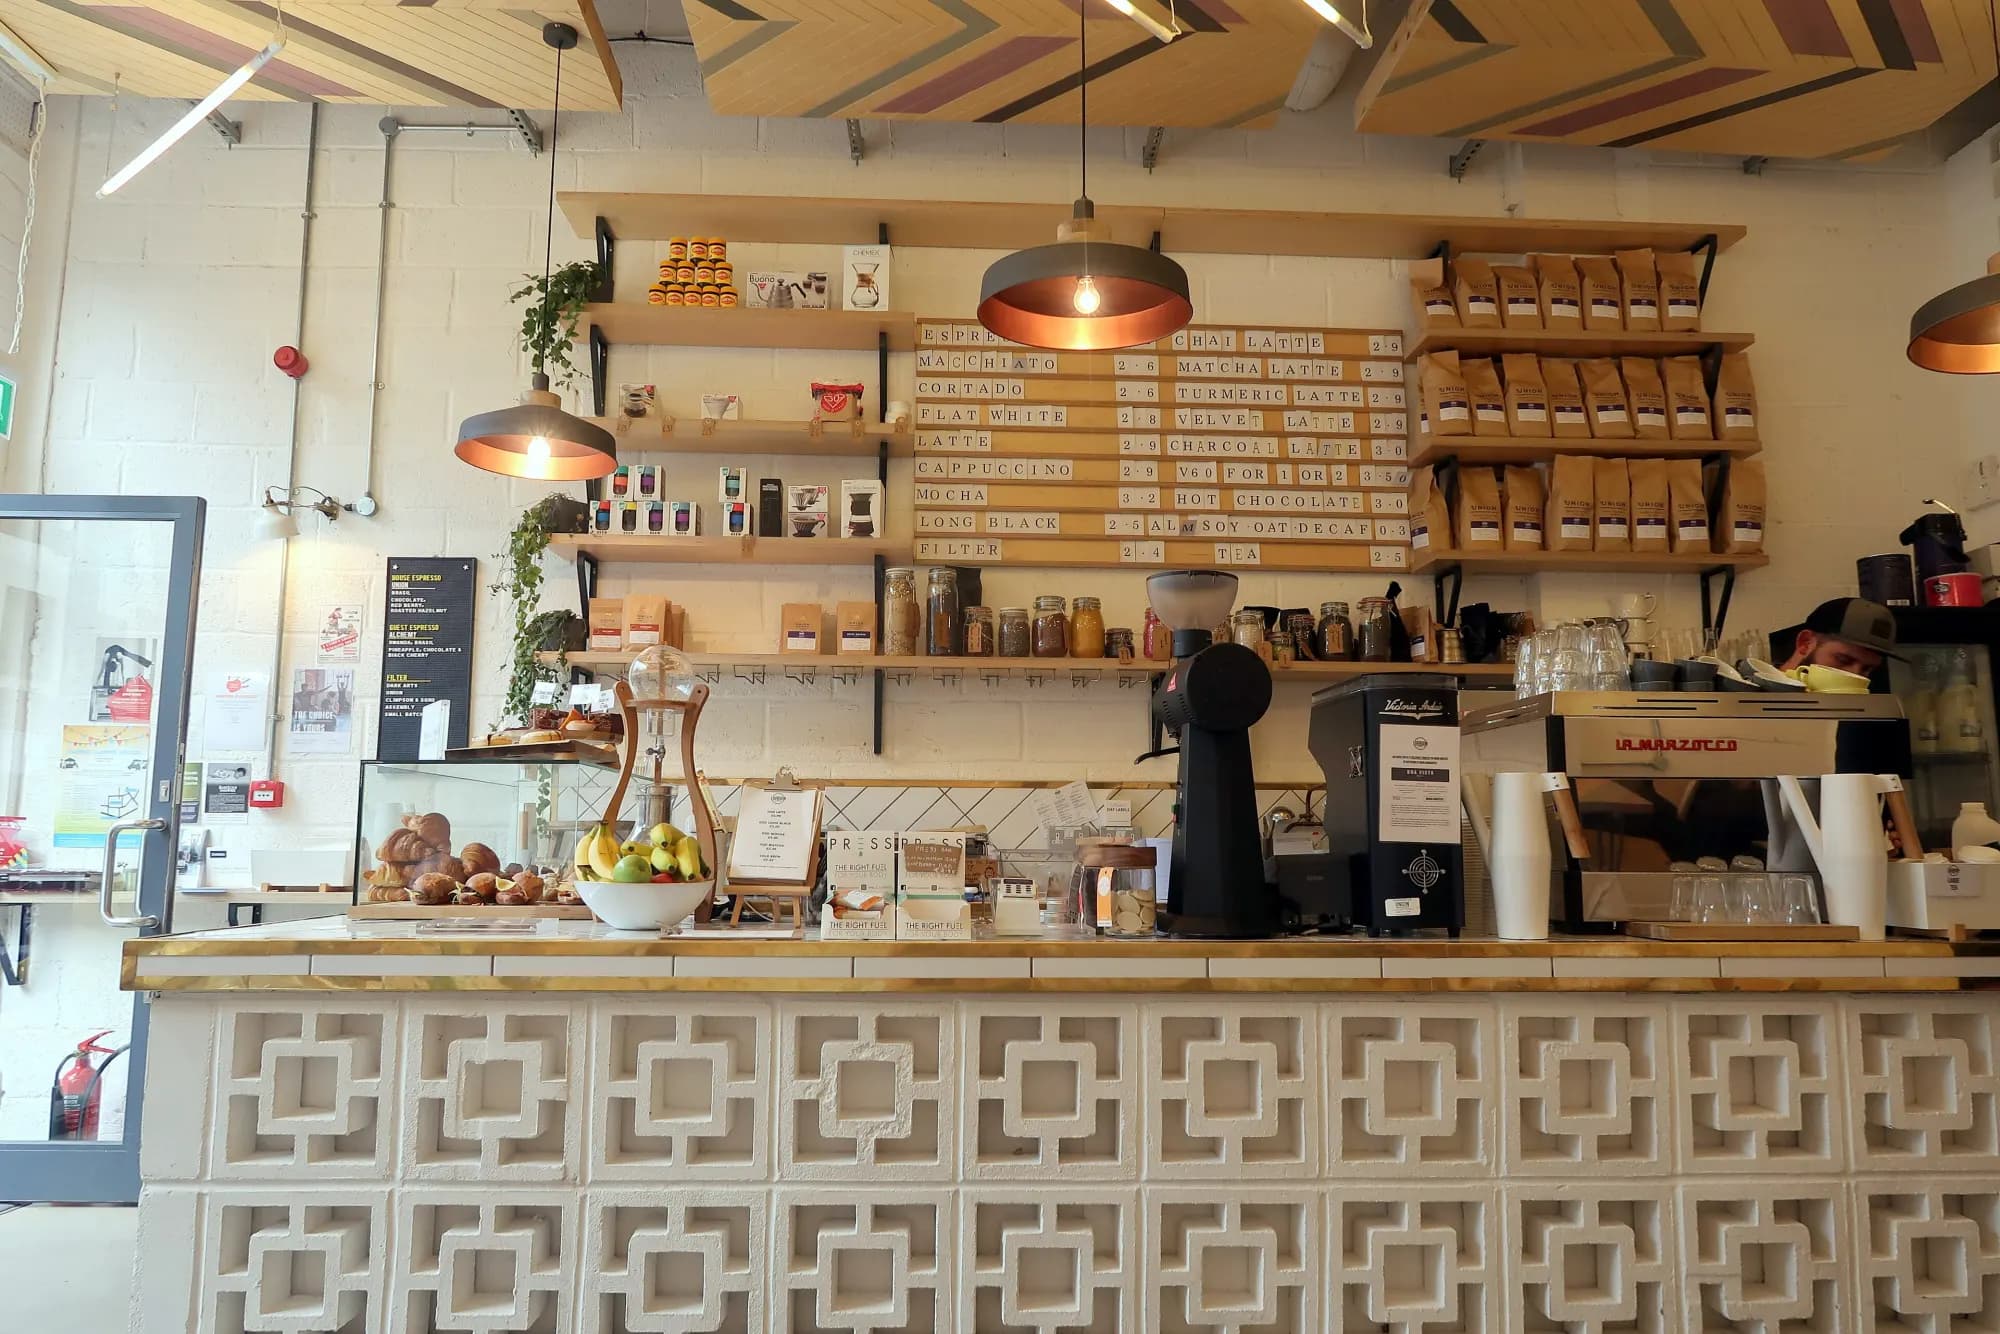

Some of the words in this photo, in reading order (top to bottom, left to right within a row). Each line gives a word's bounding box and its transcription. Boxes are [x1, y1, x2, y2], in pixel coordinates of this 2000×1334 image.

[750, 274, 774, 283] Buono
[925, 329, 1009, 343] ESPRE
[1175, 335, 1231, 346] CHAI
[1248, 336, 1320, 348] LATTE
[919, 355, 1055, 370] MACCHIATO
[1179, 361, 1258, 373] MATCHA
[1271, 363, 1339, 376] LATTE
[918, 383, 1022, 395] CORTADO
[1179, 388, 1284, 400] TURMERIC
[1297, 390, 1360, 402] LATTE
[921, 408, 977, 420] FLAT
[991, 410, 1063, 422] WHITE
[1178, 414, 1260, 427] VELVET
[1287, 416, 1350, 429] LATTE
[918, 435, 988, 447] LATTE
[1170, 440, 1275, 454] CHARCOAL
[1291, 442, 1357, 456] LATTE
[918, 463, 1070, 476] CAPPUCCINO
[1180, 466, 1212, 478] V60
[1227, 468, 1265, 480] FOR
[1281, 470, 1288, 480] 1
[1301, 469, 1324, 481] OR
[1335, 471, 1343, 481] 2
[916, 489, 985, 500] MOCHA
[1177, 494, 1217, 505] HOT
[1237, 495, 1360, 508] CHOCOLATE
[920, 516, 973, 527] LONG
[989, 517, 1056, 529] BLACK
[1203, 521, 1239, 532] SOY
[920, 544, 998, 555] FILTER
[1218, 548, 1257, 560] TEA
[830, 837, 892, 850] PRESS
[846, 921, 868, 929] RIGHT
